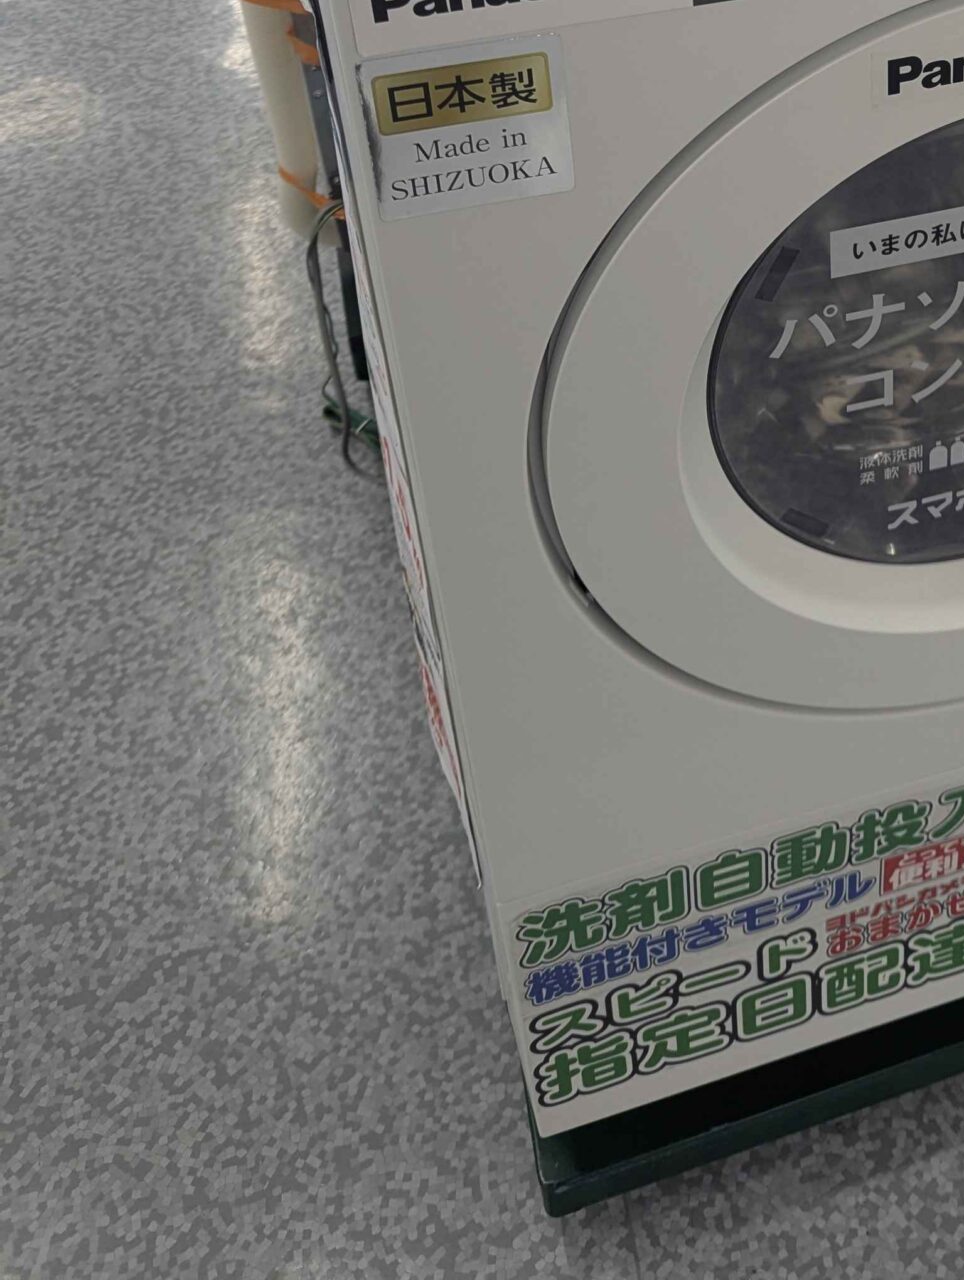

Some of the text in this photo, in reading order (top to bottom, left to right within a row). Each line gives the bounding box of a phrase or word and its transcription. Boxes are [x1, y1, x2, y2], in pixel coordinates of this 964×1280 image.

[387, 68, 538, 124] 日本製
[413, 127, 527, 164] Made in
[390, 154, 558, 203] SHIZUOKA
[859, 443, 924, 471] 液体洗剤
[526, 871, 878, 1006] 機能付きモデル
[531, 926, 818, 1054] スピード
